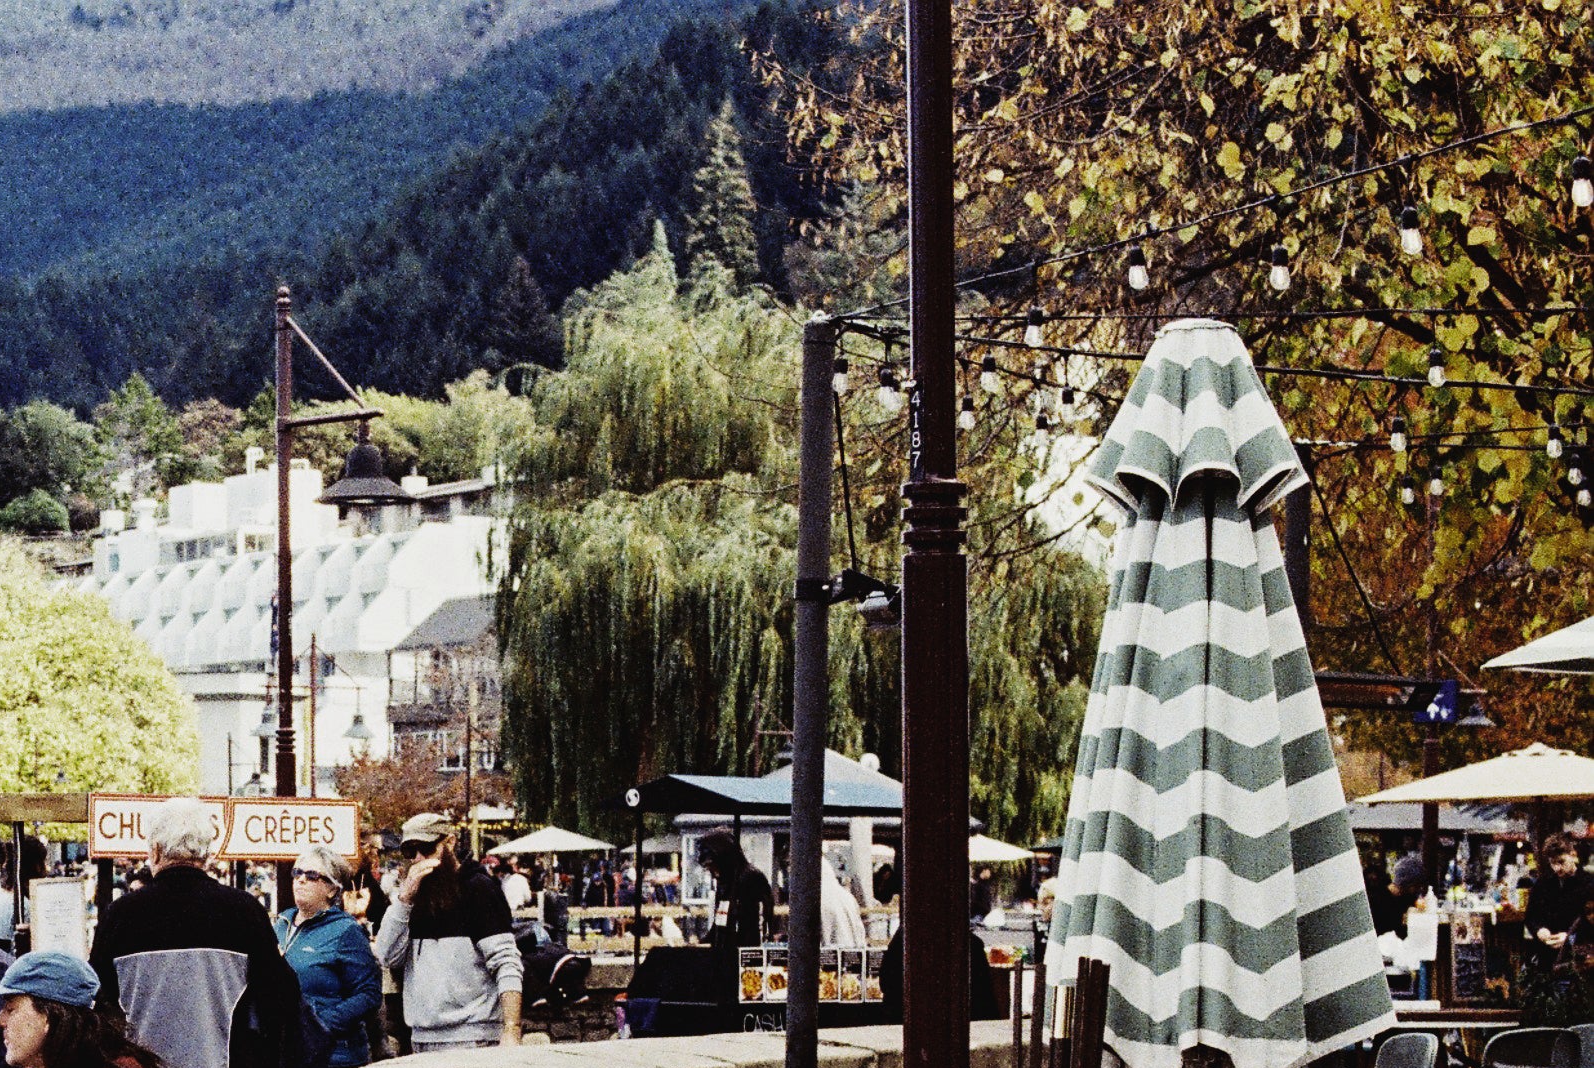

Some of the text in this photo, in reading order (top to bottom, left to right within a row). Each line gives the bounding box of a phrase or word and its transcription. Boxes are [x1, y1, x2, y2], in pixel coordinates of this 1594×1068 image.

[911, 391, 921, 468] 4187
[99, 811, 219, 841] CHUS
[245, 809, 335, 844] CRÊPES
